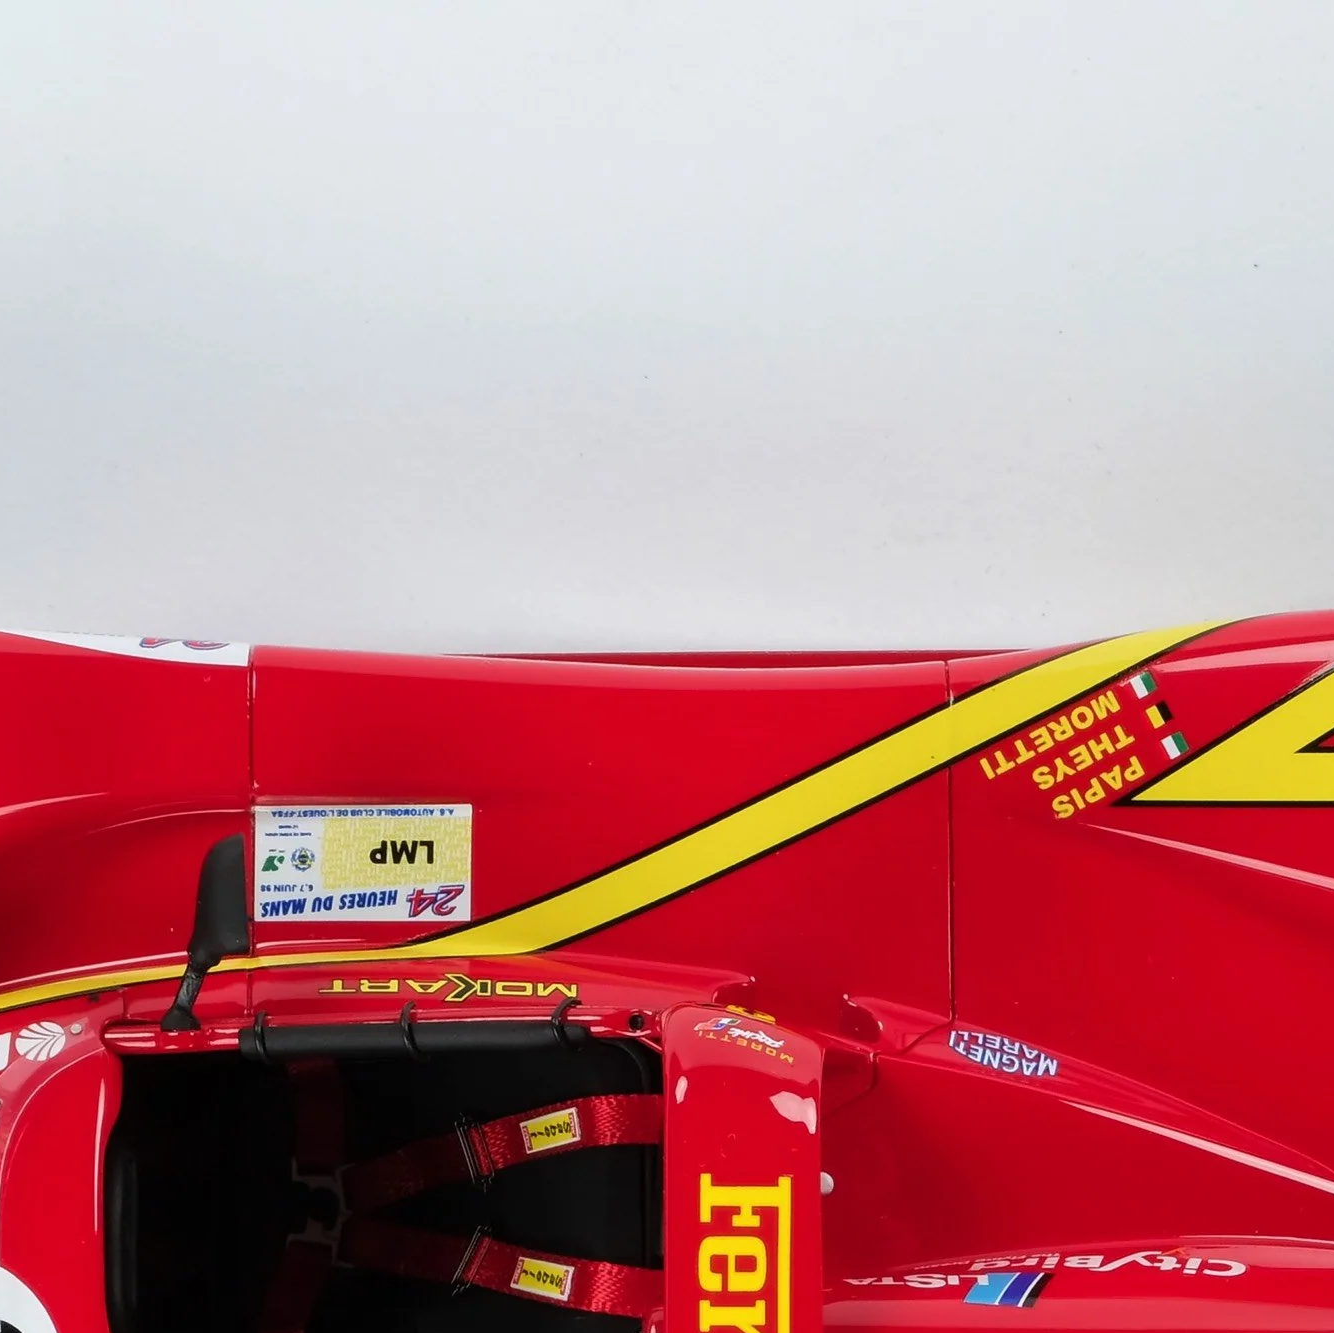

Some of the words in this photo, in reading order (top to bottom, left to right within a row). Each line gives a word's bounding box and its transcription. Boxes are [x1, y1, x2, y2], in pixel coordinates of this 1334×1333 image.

[978, 690, 1121, 780] MORETTI
[1032, 724, 1135, 791] THEYS
[1051, 755, 1146, 819] PAPIS
[336, 808, 349, 817] DE
[351, 808, 375, 817] CLUB
[376, 808, 435, 817] AUTOMOBILE
[370, 840, 434, 865] LMP
[312, 895, 334, 913] DU
[339, 889, 398, 911] HEURES
[406, 884, 465, 918] 24
[319, 973, 578, 1003] MOKART
[697, 1030, 794, 1065] MORETTI
[948, 1030, 1058, 1064] MARELLI
[948, 1041, 1058, 1077] MAGNETI
[843, 1272, 989, 1290] LISTA
